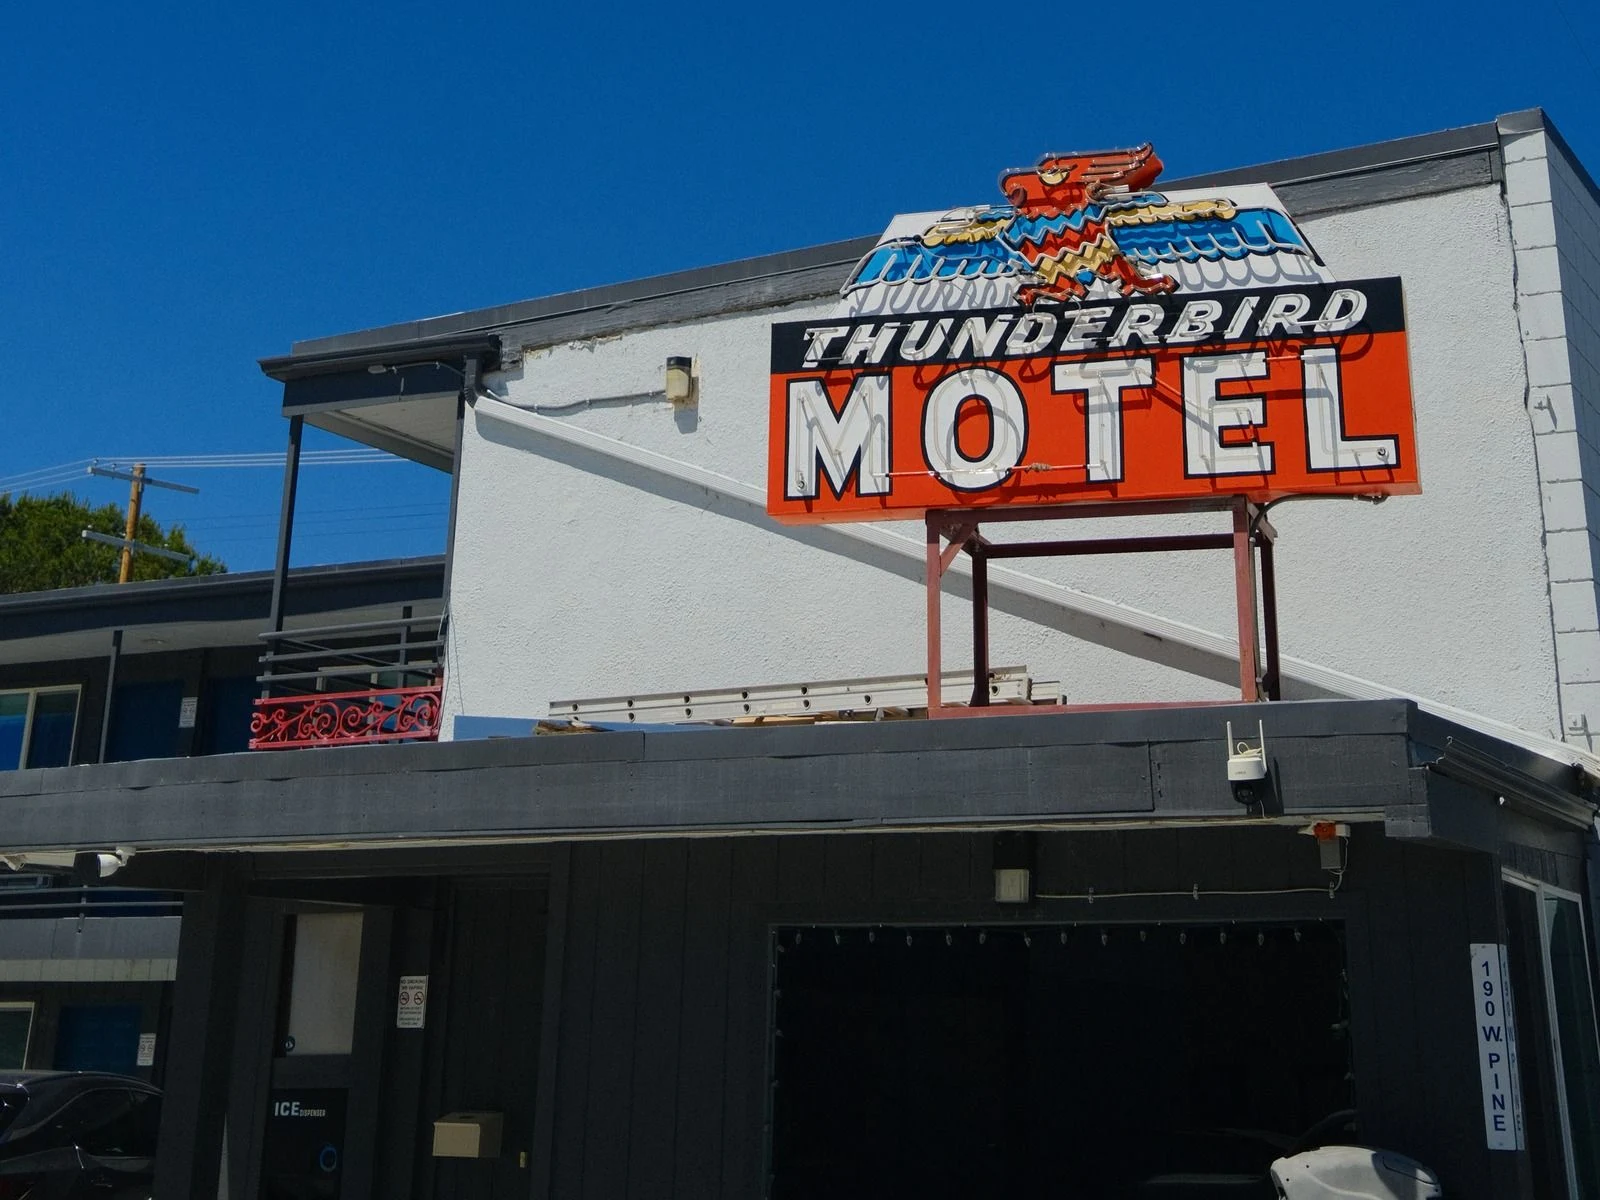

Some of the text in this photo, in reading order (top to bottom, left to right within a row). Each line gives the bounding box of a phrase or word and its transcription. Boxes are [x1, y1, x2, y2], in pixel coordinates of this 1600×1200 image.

[800, 287, 1368, 369] THUNDERBIRD
[785, 346, 1399, 501] MOTEL
[1481, 960, 1495, 1017] 190
[1488, 1052, 1507, 1132] PINE
[274, 1101, 326, 1117] ICE DISPENSER
